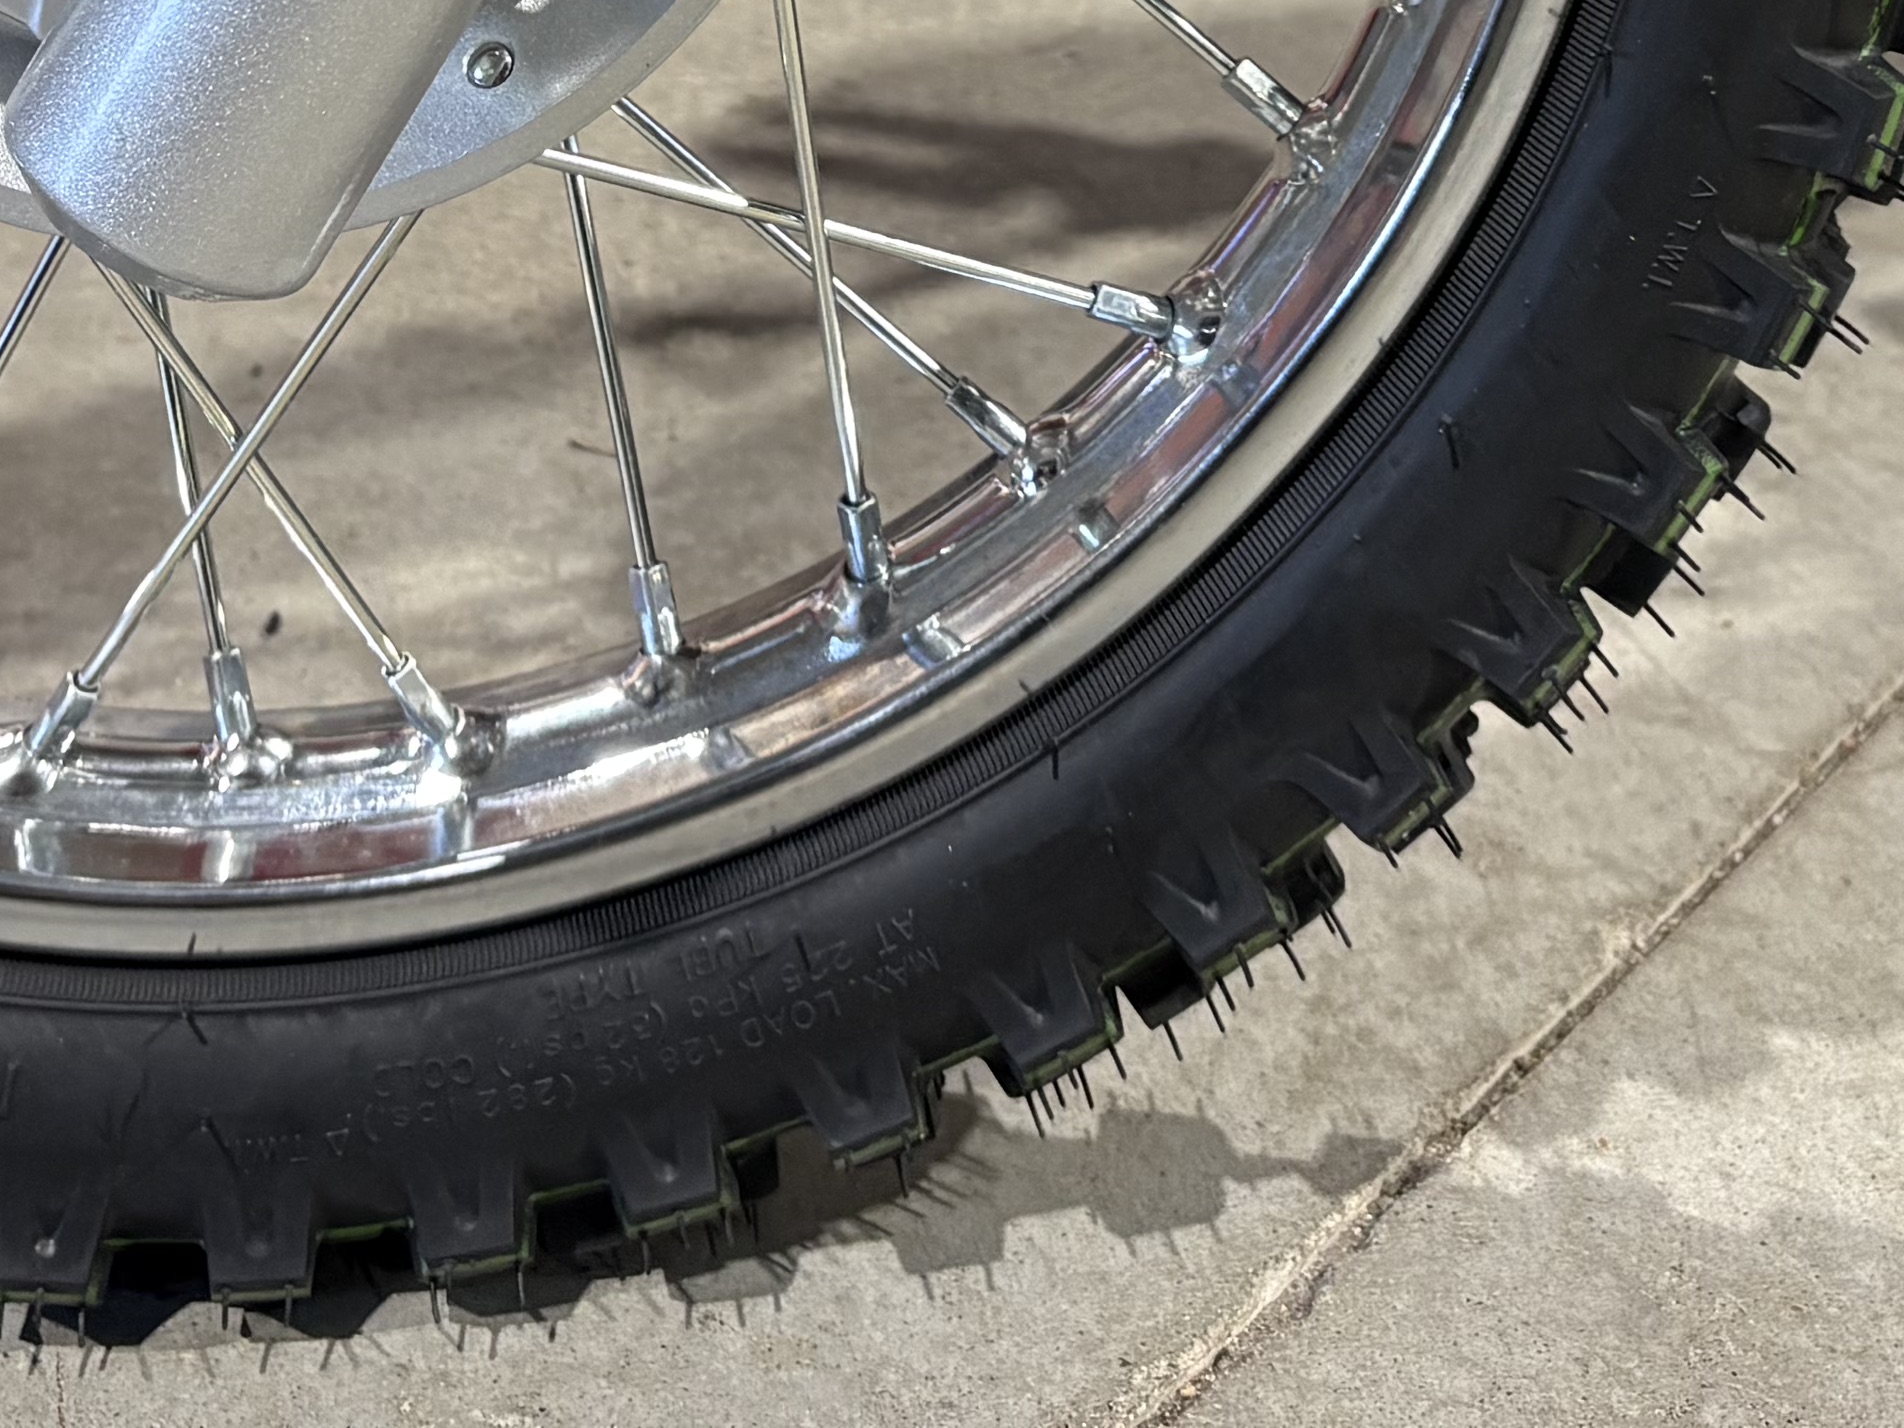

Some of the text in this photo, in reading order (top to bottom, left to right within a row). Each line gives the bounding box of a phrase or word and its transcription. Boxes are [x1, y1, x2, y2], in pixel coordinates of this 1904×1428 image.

[875, 906, 915, 958] AT
[847, 945, 943, 1001] MAX.
[739, 988, 843, 1048] LOAD
[373, 1053, 475, 1098] COLD
[657, 1034, 725, 1075] 128
